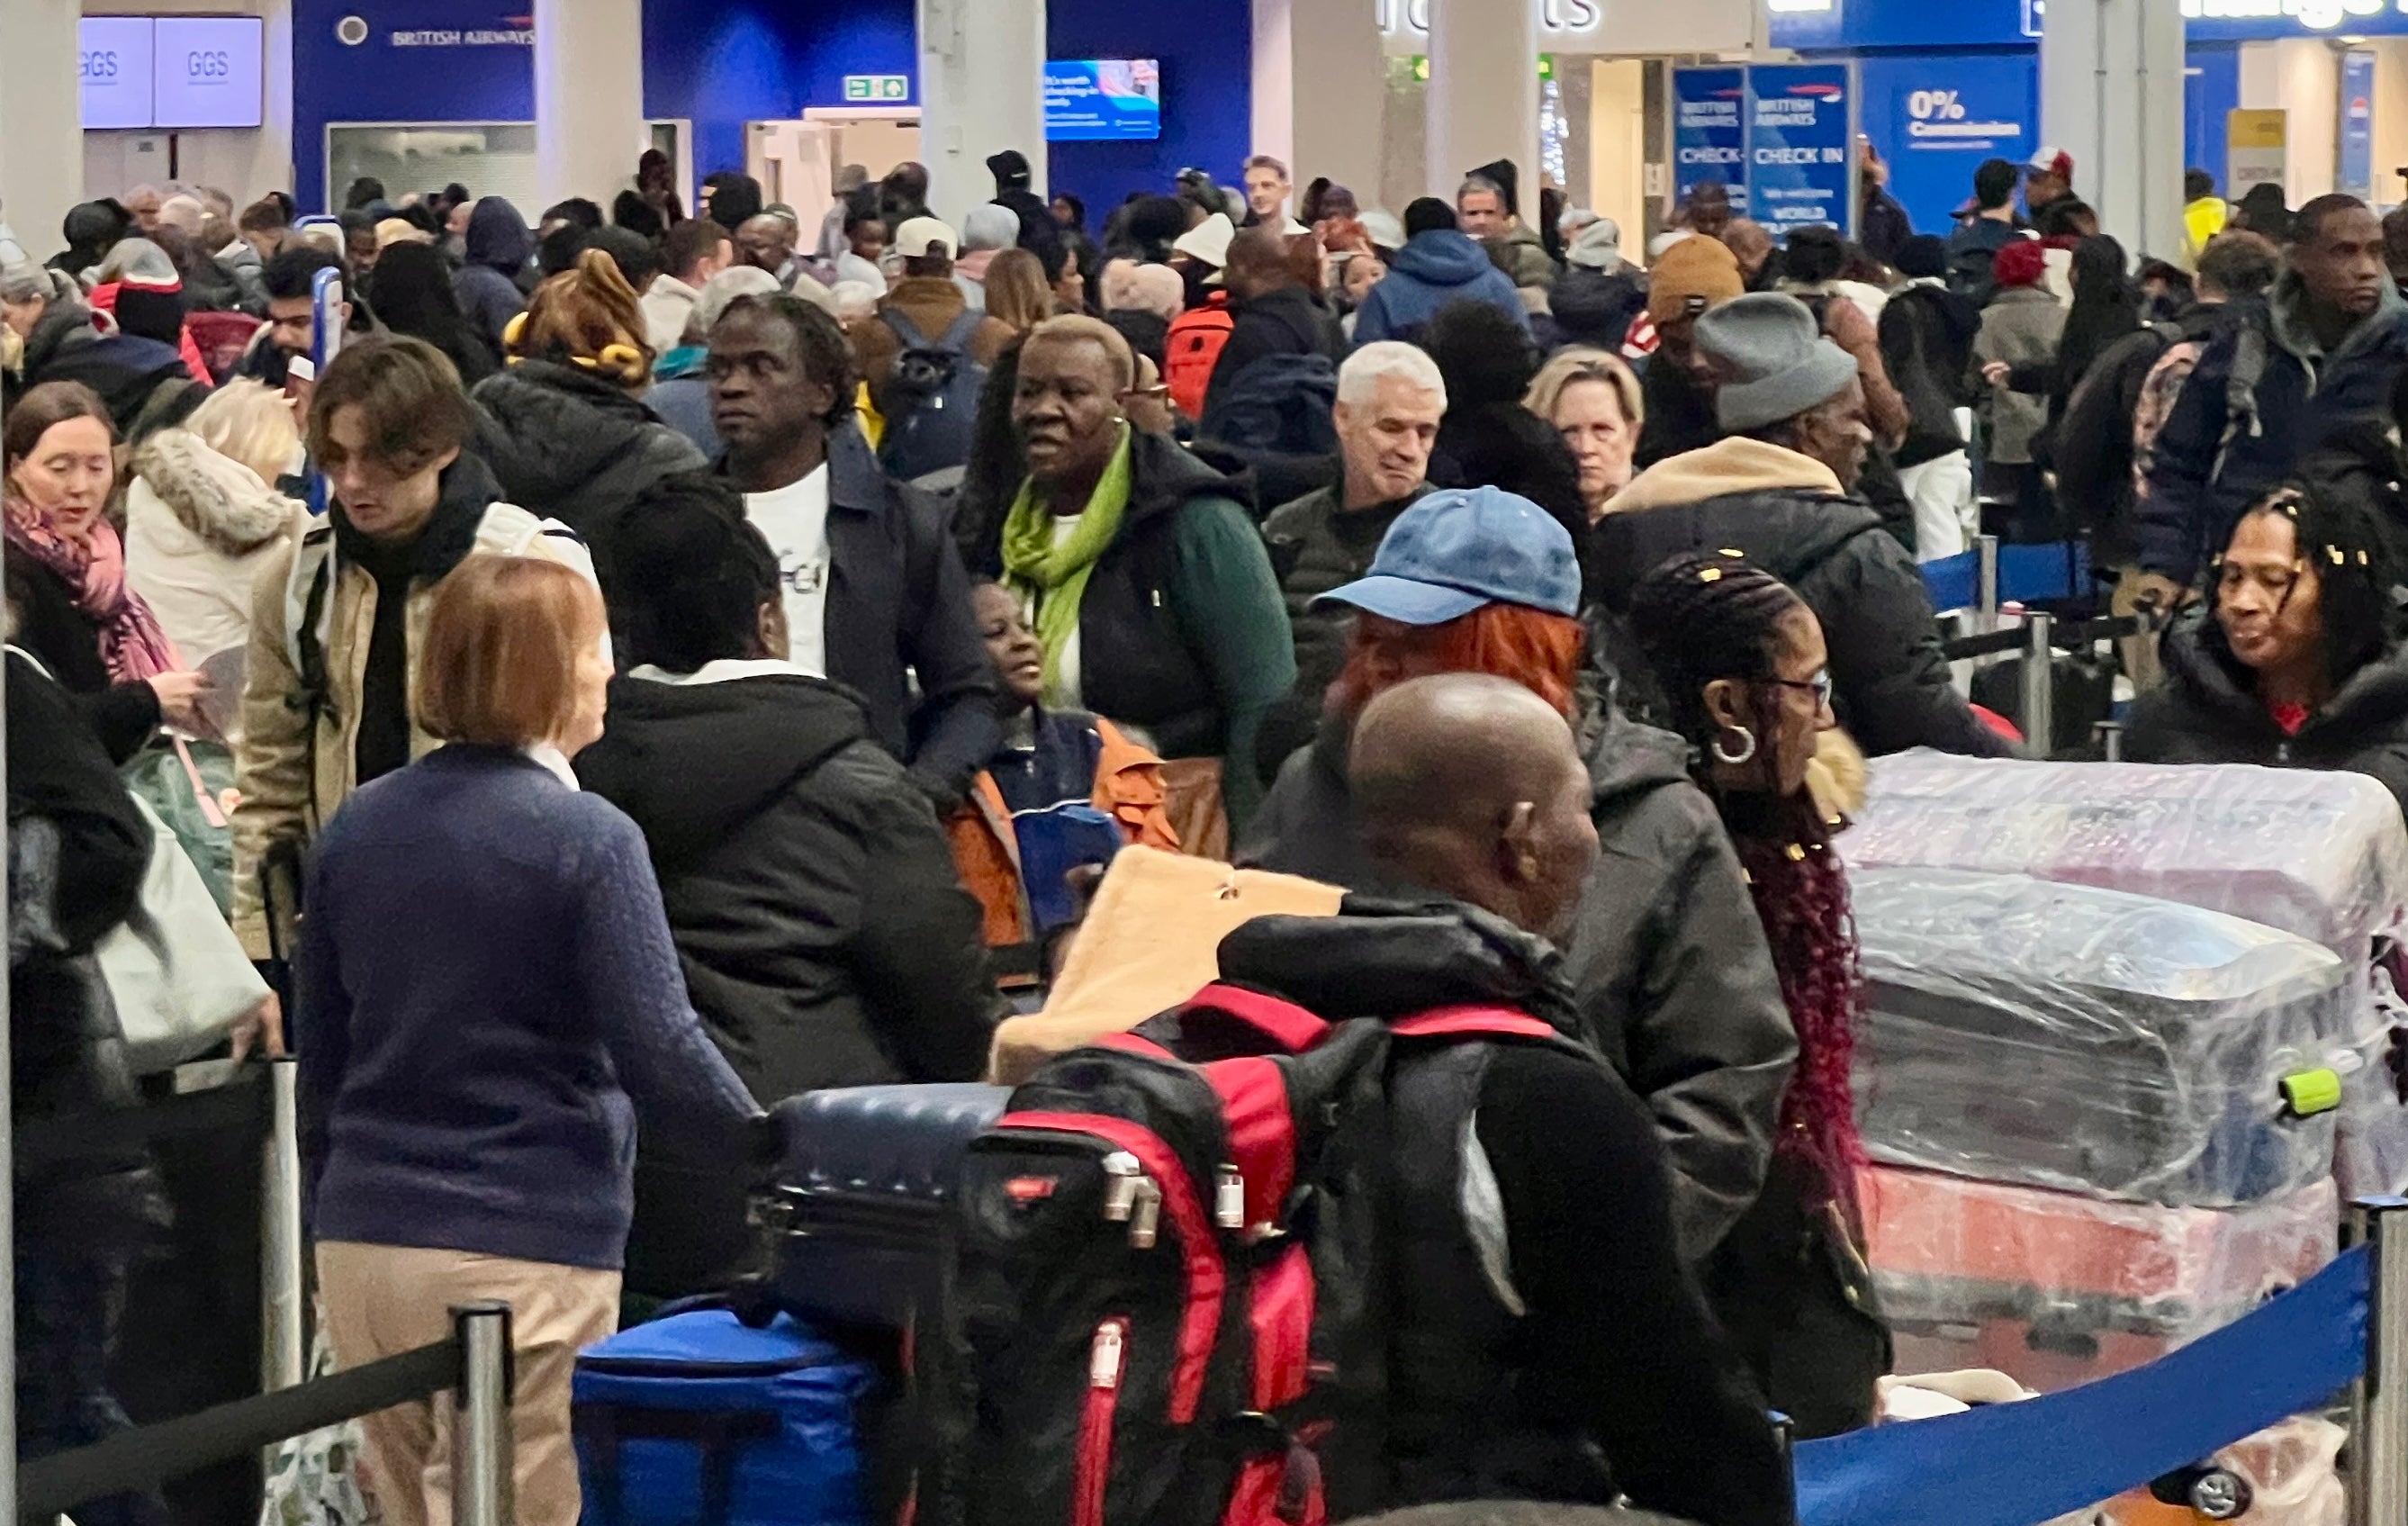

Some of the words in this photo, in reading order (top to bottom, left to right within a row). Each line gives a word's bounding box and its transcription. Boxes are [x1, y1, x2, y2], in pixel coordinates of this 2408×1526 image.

[392, 32, 461, 46] BRITISH
[187, 51, 229, 77] GGS
[1757, 99, 1816, 113] BRITISH
[1909, 90, 1965, 119] 0%
[1755, 148, 1818, 164] CHECK
[1822, 148, 1844, 163] IN
